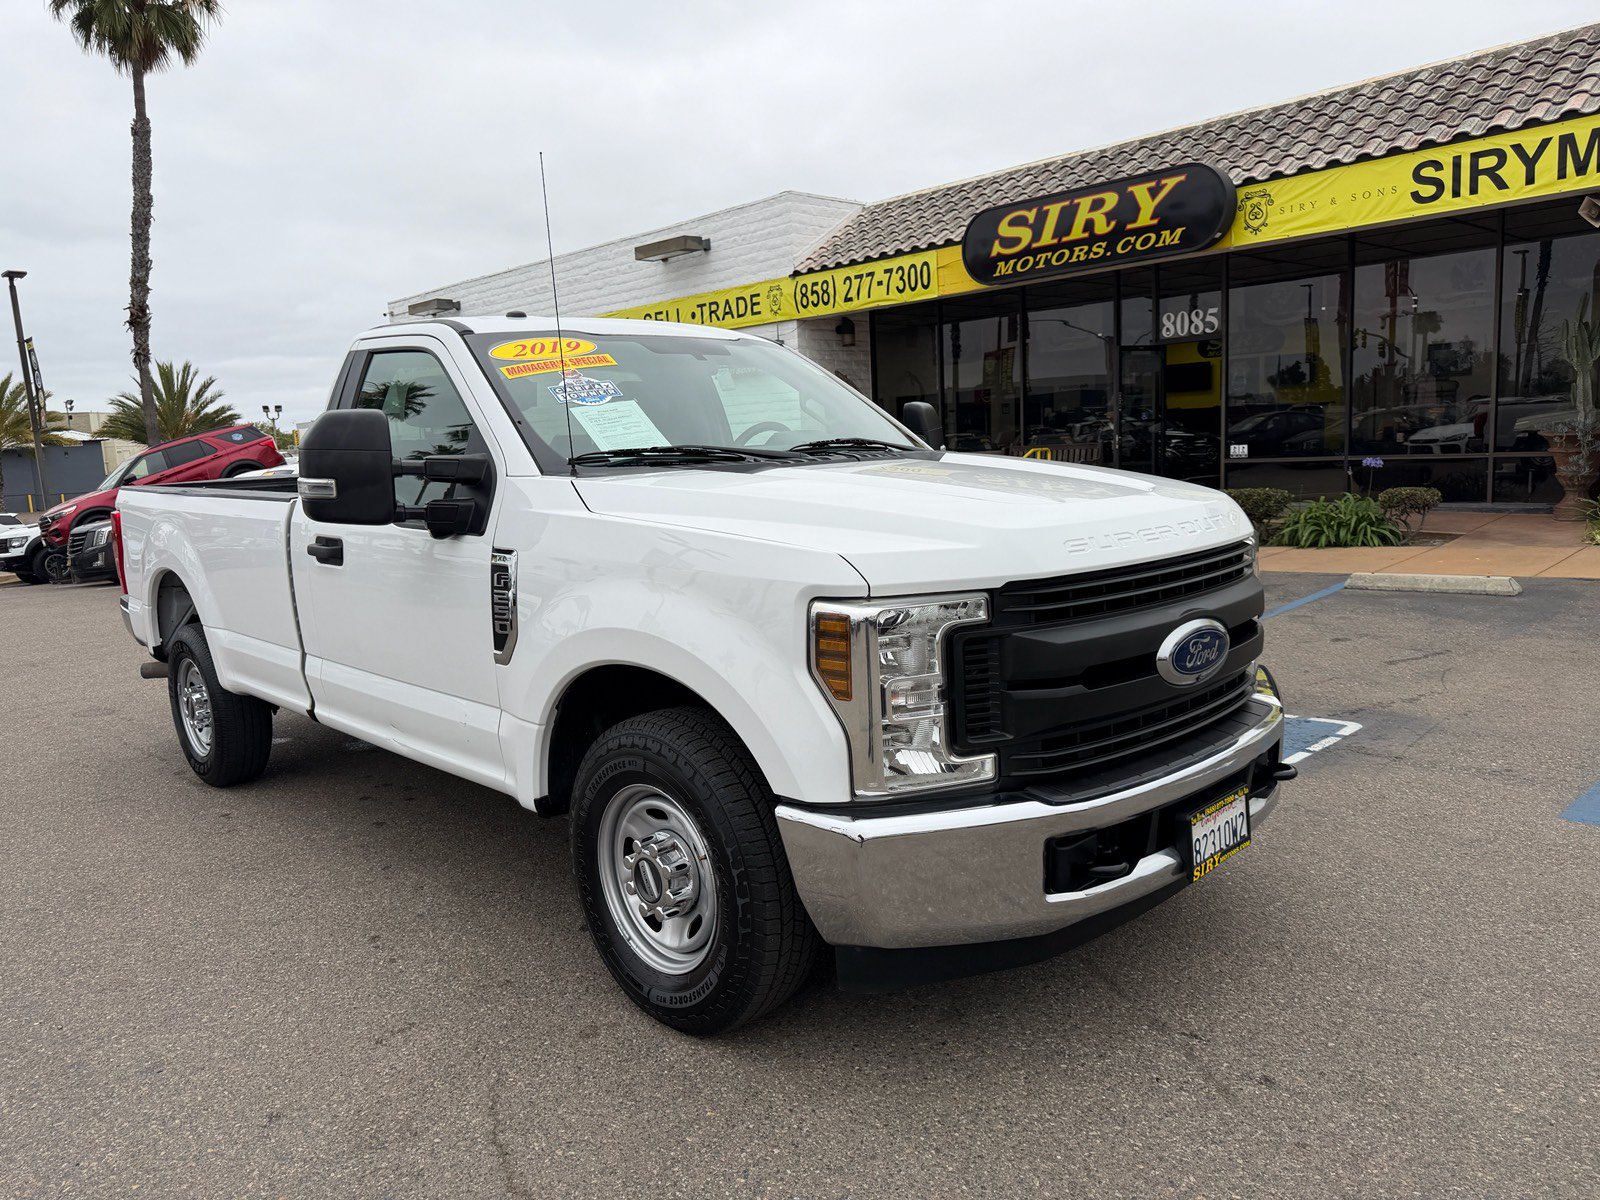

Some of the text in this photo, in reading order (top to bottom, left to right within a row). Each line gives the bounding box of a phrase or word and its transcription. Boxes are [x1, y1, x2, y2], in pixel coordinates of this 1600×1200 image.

[990, 173, 1188, 258] SIRY
[1279, 185, 1398, 215] SIRY & SONS
[992, 226, 1186, 279] MOTORS.COM
[793, 260, 932, 314] (858) 277-7300
[696, 292, 762, 325] TRADE
[1161, 307, 1219, 338] 8085
[513, 340, 581, 358] 2019
[570, 353, 612, 369] SPECIAL
[1063, 525, 1180, 556] SUPER
[1186, 636, 1220, 668] Ford
[1193, 852, 1222, 881] SIRY
